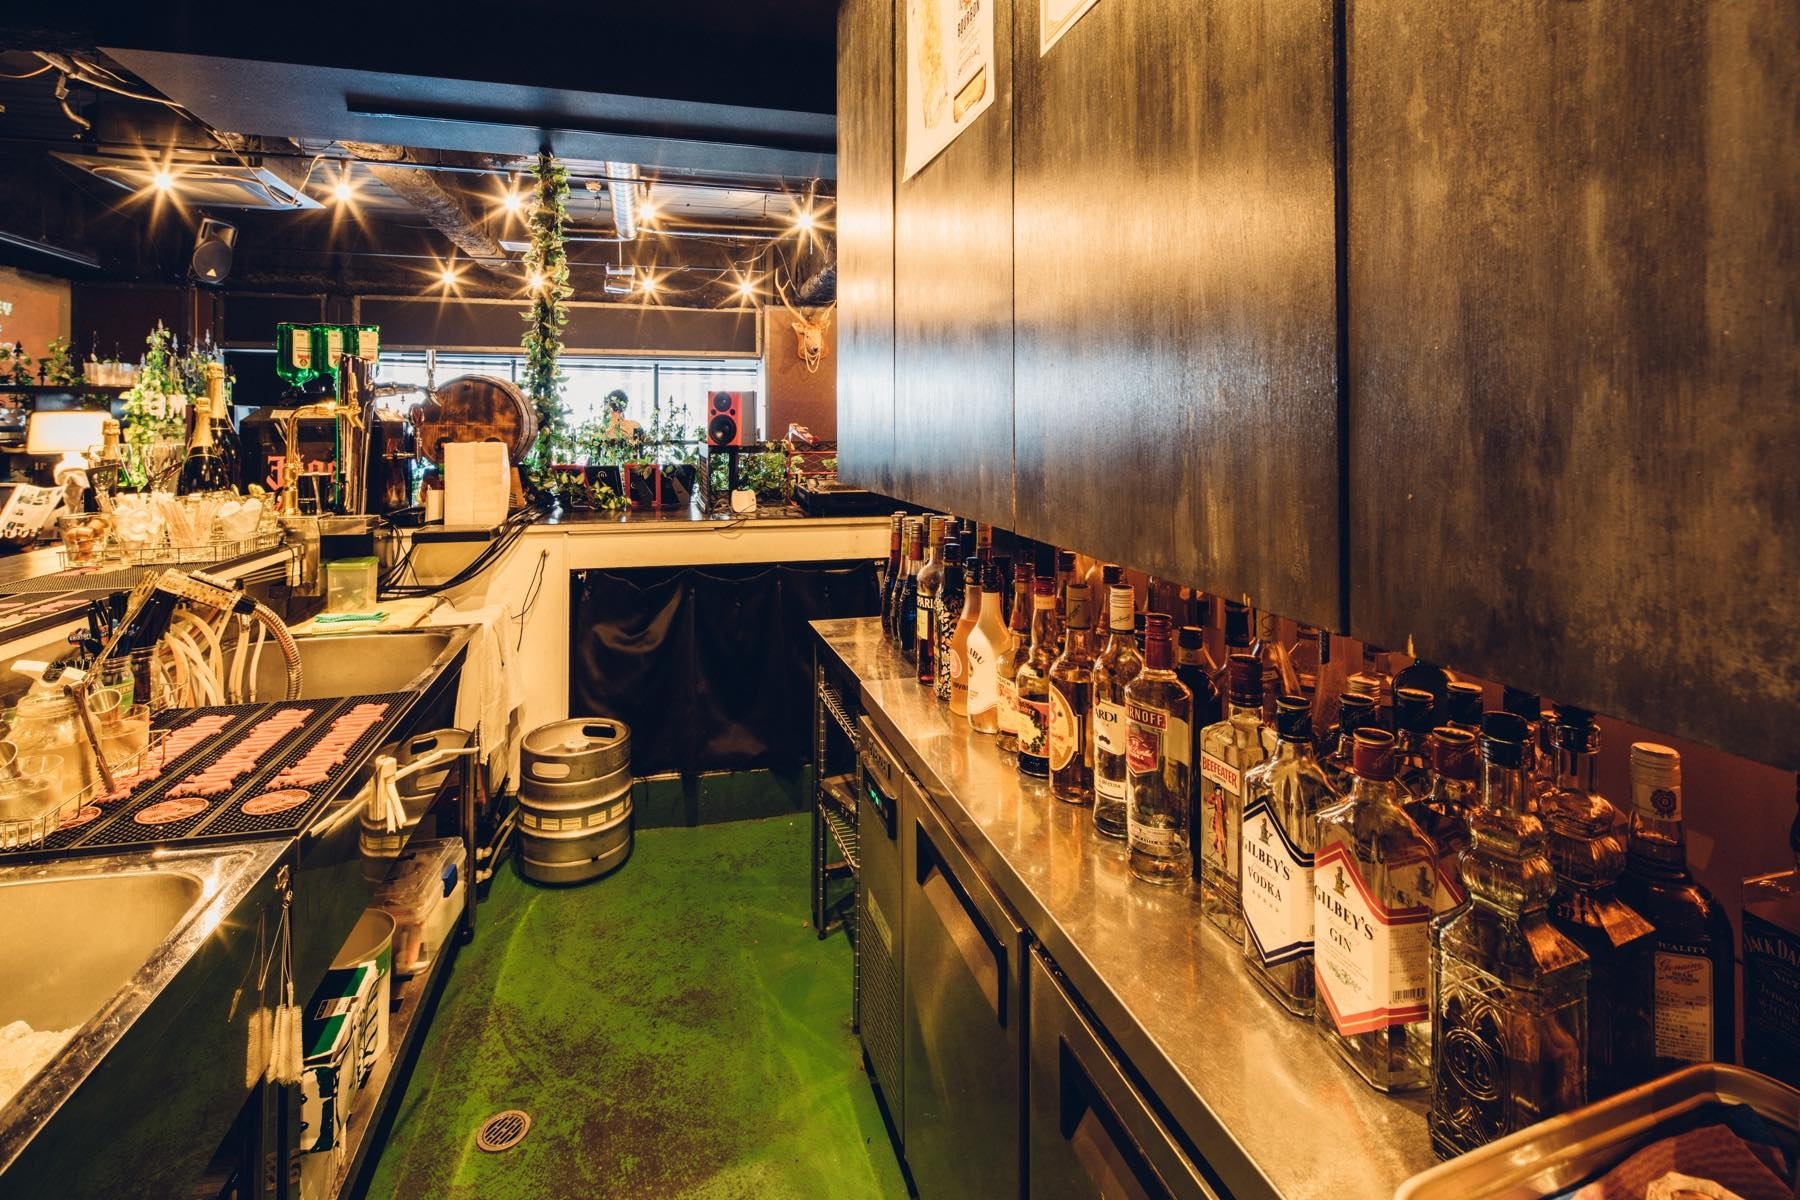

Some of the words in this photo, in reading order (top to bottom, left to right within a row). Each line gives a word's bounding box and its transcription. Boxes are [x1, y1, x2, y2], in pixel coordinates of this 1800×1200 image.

[1202, 756, 1238, 790] BEEFEATER
[1248, 866, 1282, 902] VODKA
[1314, 885, 1374, 940] GILBEY'S
[1329, 928, 1352, 953] GIN
